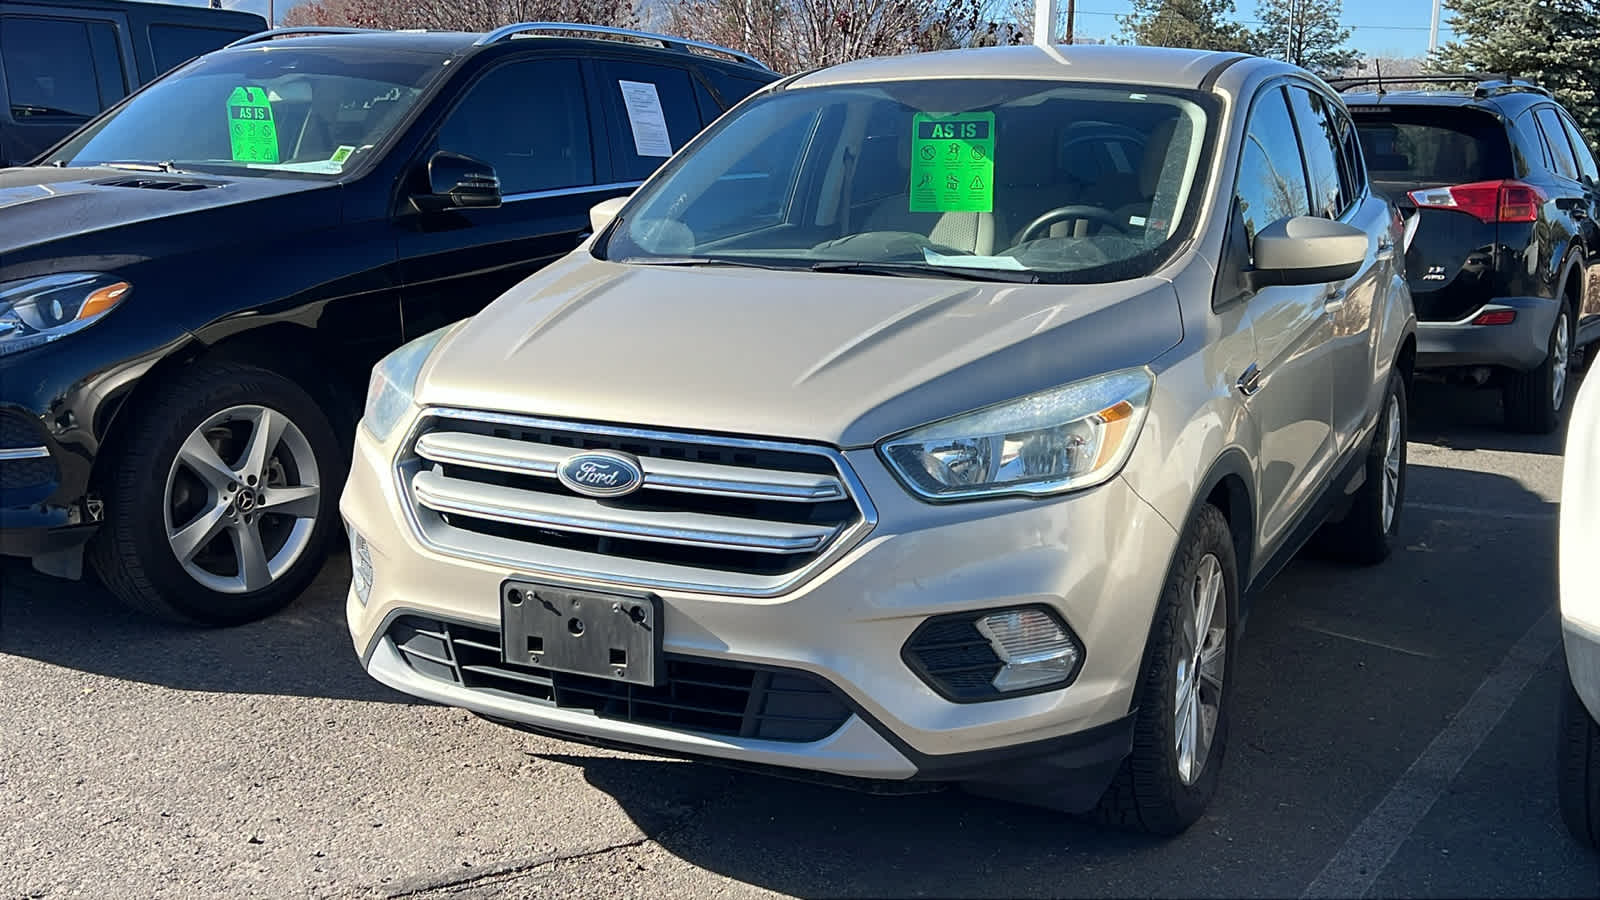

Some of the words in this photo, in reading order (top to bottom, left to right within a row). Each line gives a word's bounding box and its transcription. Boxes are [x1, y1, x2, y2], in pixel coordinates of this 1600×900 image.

[240, 107, 252, 119] AS
[254, 107, 265, 119] IS
[931, 123, 954, 138] AS
[961, 123, 977, 138] IS
[575, 461, 620, 486] Ford
